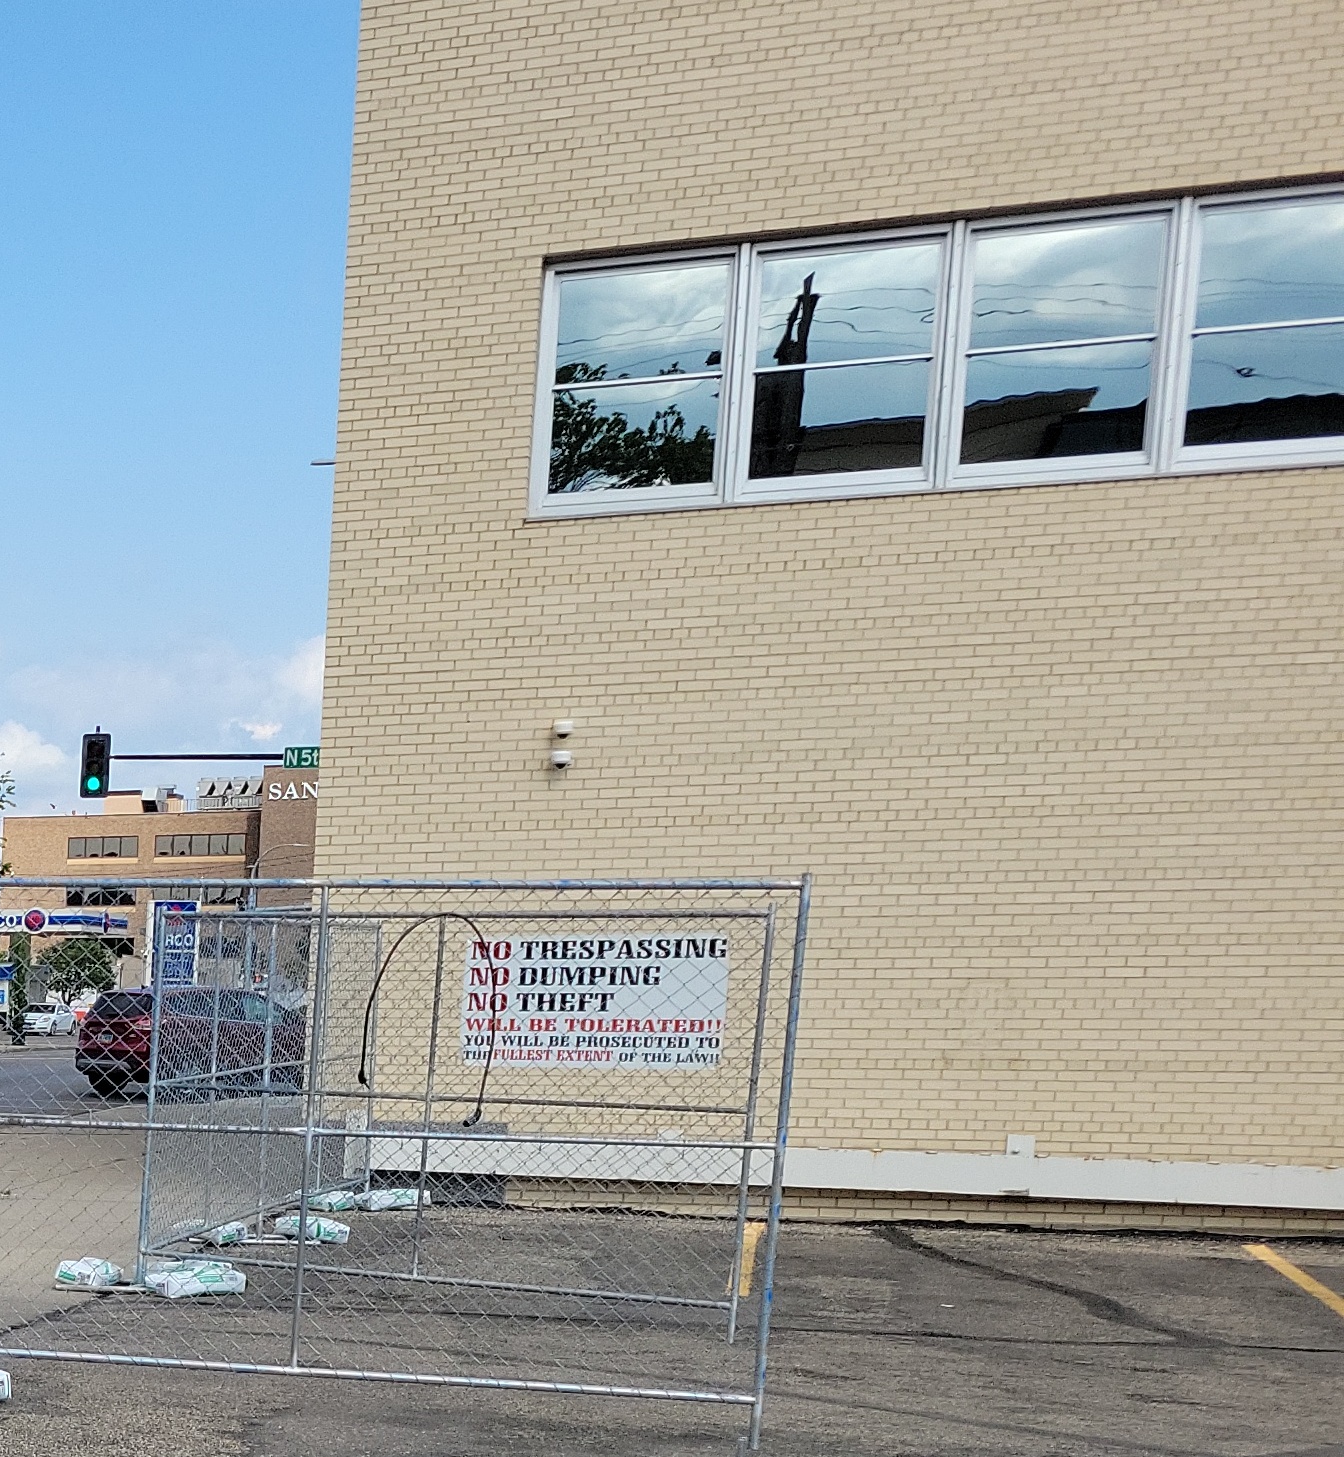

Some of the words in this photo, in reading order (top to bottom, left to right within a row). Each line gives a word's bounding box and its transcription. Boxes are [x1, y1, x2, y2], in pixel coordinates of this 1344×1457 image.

[286, 750, 298, 766] N
[301, 749, 319, 766] 5t
[471, 940, 511, 961] NO
[520, 938, 728, 961] TRESPASSING
[469, 966, 510, 986] NO
[518, 966, 661, 986] DUMPING
[466, 992, 508, 1012] NO
[516, 992, 615, 1013] THEFT
[466, 1018, 521, 1032] WILL
[528, 1018, 557, 1032] BE
[564, 1018, 722, 1034] TOLERATED!!
[464, 1035, 492, 1047] YOU
[501, 1035, 543, 1047] WILL
[548, 1035, 570, 1048] BE
[575, 1035, 690, 1049] PROSECUTED
[695, 1037, 720, 1049] TO
[493, 1049, 552, 1061] FULLEST
[556, 1050, 613, 1062] EXTENT
[618, 1052, 637, 1063] OF
[641, 1053, 672, 1064] THE
